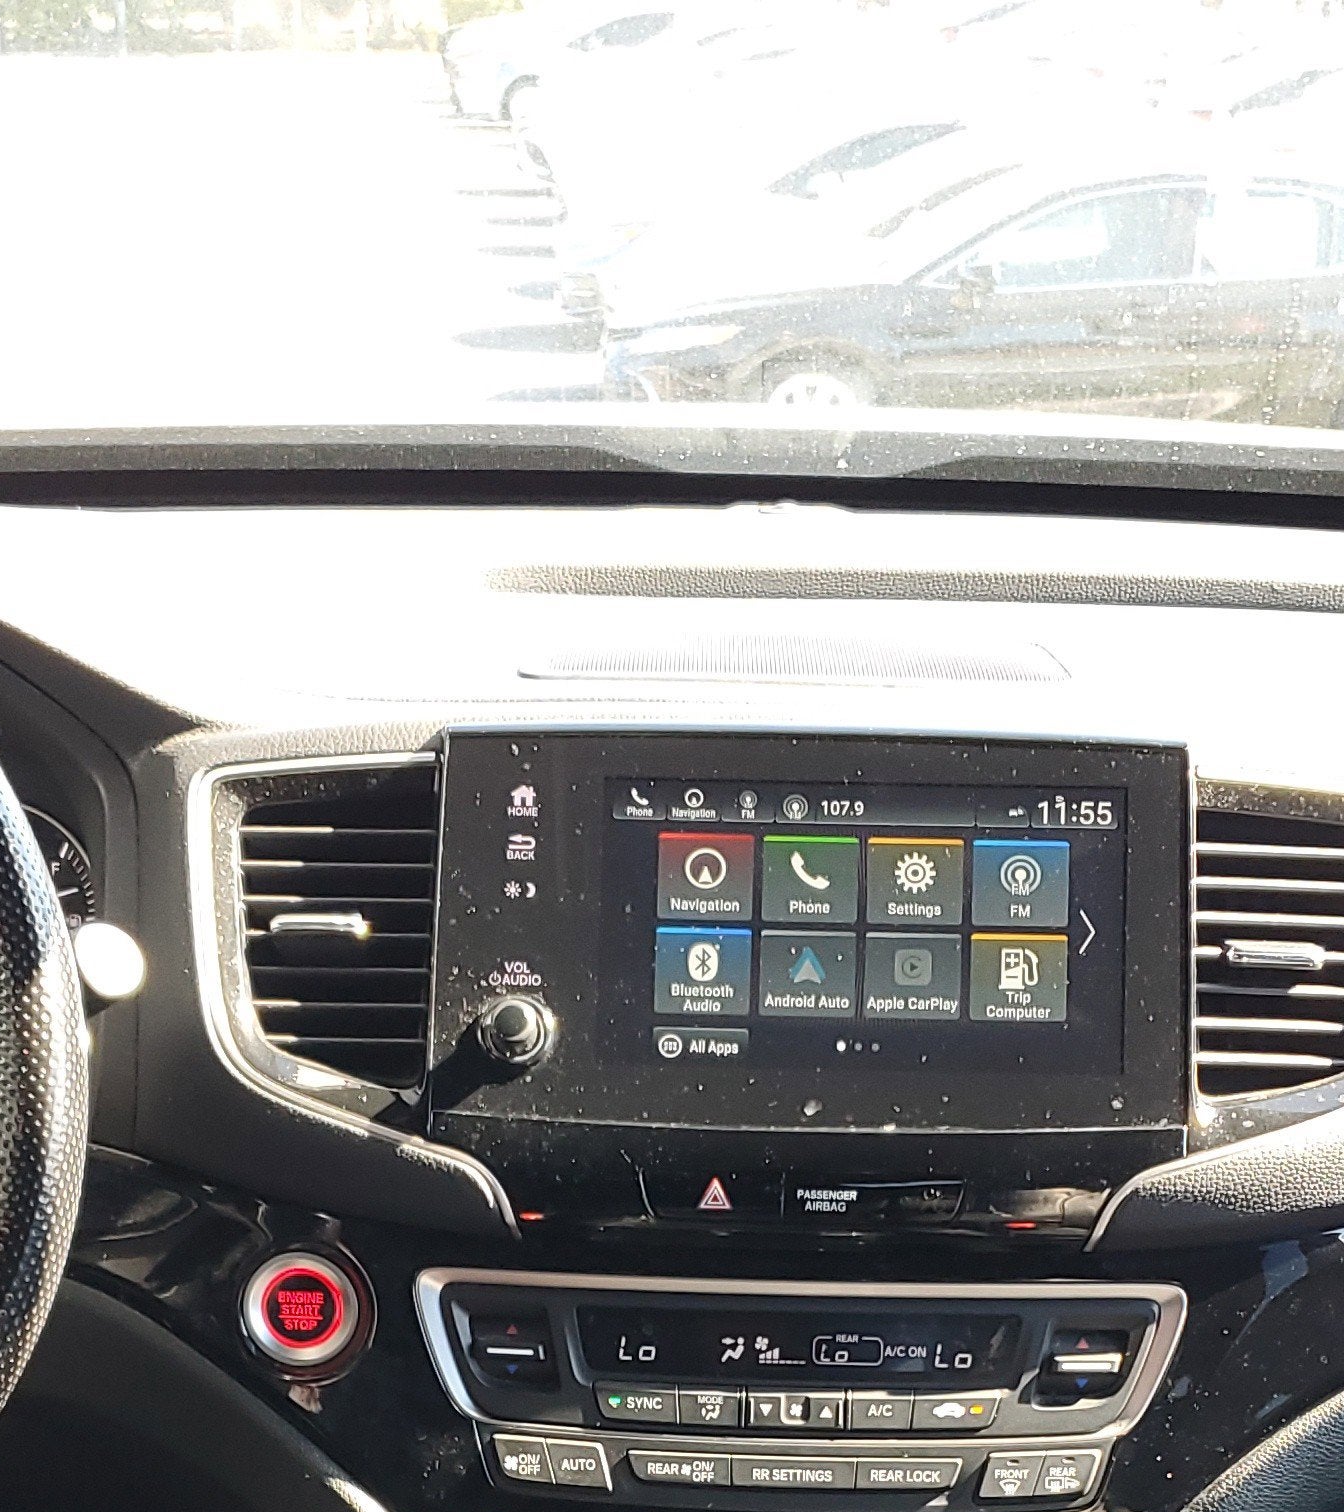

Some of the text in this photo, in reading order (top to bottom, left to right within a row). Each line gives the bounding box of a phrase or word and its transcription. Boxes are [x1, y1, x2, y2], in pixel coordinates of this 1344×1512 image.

[507, 806, 539, 817] HOME
[626, 806, 654, 817] Phone
[671, 808, 716, 820] Navigation
[741, 809, 755, 819] FM
[820, 800, 865, 816] 107.9
[1037, 800, 1113, 825] 11:55
[506, 850, 536, 861] BACK
[670, 897, 740, 914] Navigation
[789, 899, 831, 914] Phone
[887, 902, 942, 919] Settings
[1010, 903, 1031, 918] FM
[504, 961, 531, 974] VOL
[502, 974, 542, 987] AUDIO
[670, 983, 734, 998] Bluetooth
[764, 993, 850, 1010] Android Auto
[1005, 991, 1032, 1006] Trip
[682, 999, 721, 1013] Audio
[866, 996, 959, 1015] Apple CarPlay
[986, 1005, 1051, 1021] Computer
[689, 1039, 739, 1057] All Apps
[796, 1189, 858, 1202] PASSENGER
[804, 1201, 847, 1213] AIRBAG
[277, 1290, 325, 1304] ENGINE
[281, 1304, 321, 1316] START
[284, 1319, 318, 1331] STOP
[835, 1334, 859, 1344] REAR
[618, 1335, 657, 1361] Lo
[884, 1345, 927, 1358] A/C ON
[934, 1343, 973, 1369] Lo
[626, 1396, 663, 1410] SYNC
[697, 1395, 724, 1404] MODE
[867, 1403, 893, 1417] A/C
[518, 1454, 541, 1465] ON/
[561, 1458, 596, 1471] AUTO
[518, 1465, 541, 1475] OFF
[647, 1460, 715, 1475] REAR ON/
[994, 1469, 1030, 1479] FRONT
[1049, 1467, 1077, 1477] REAR
[692, 1472, 715, 1483] OFF
[752, 1467, 833, 1482] RR SETTINGS
[870, 1469, 941, 1482] REAR LOCK
